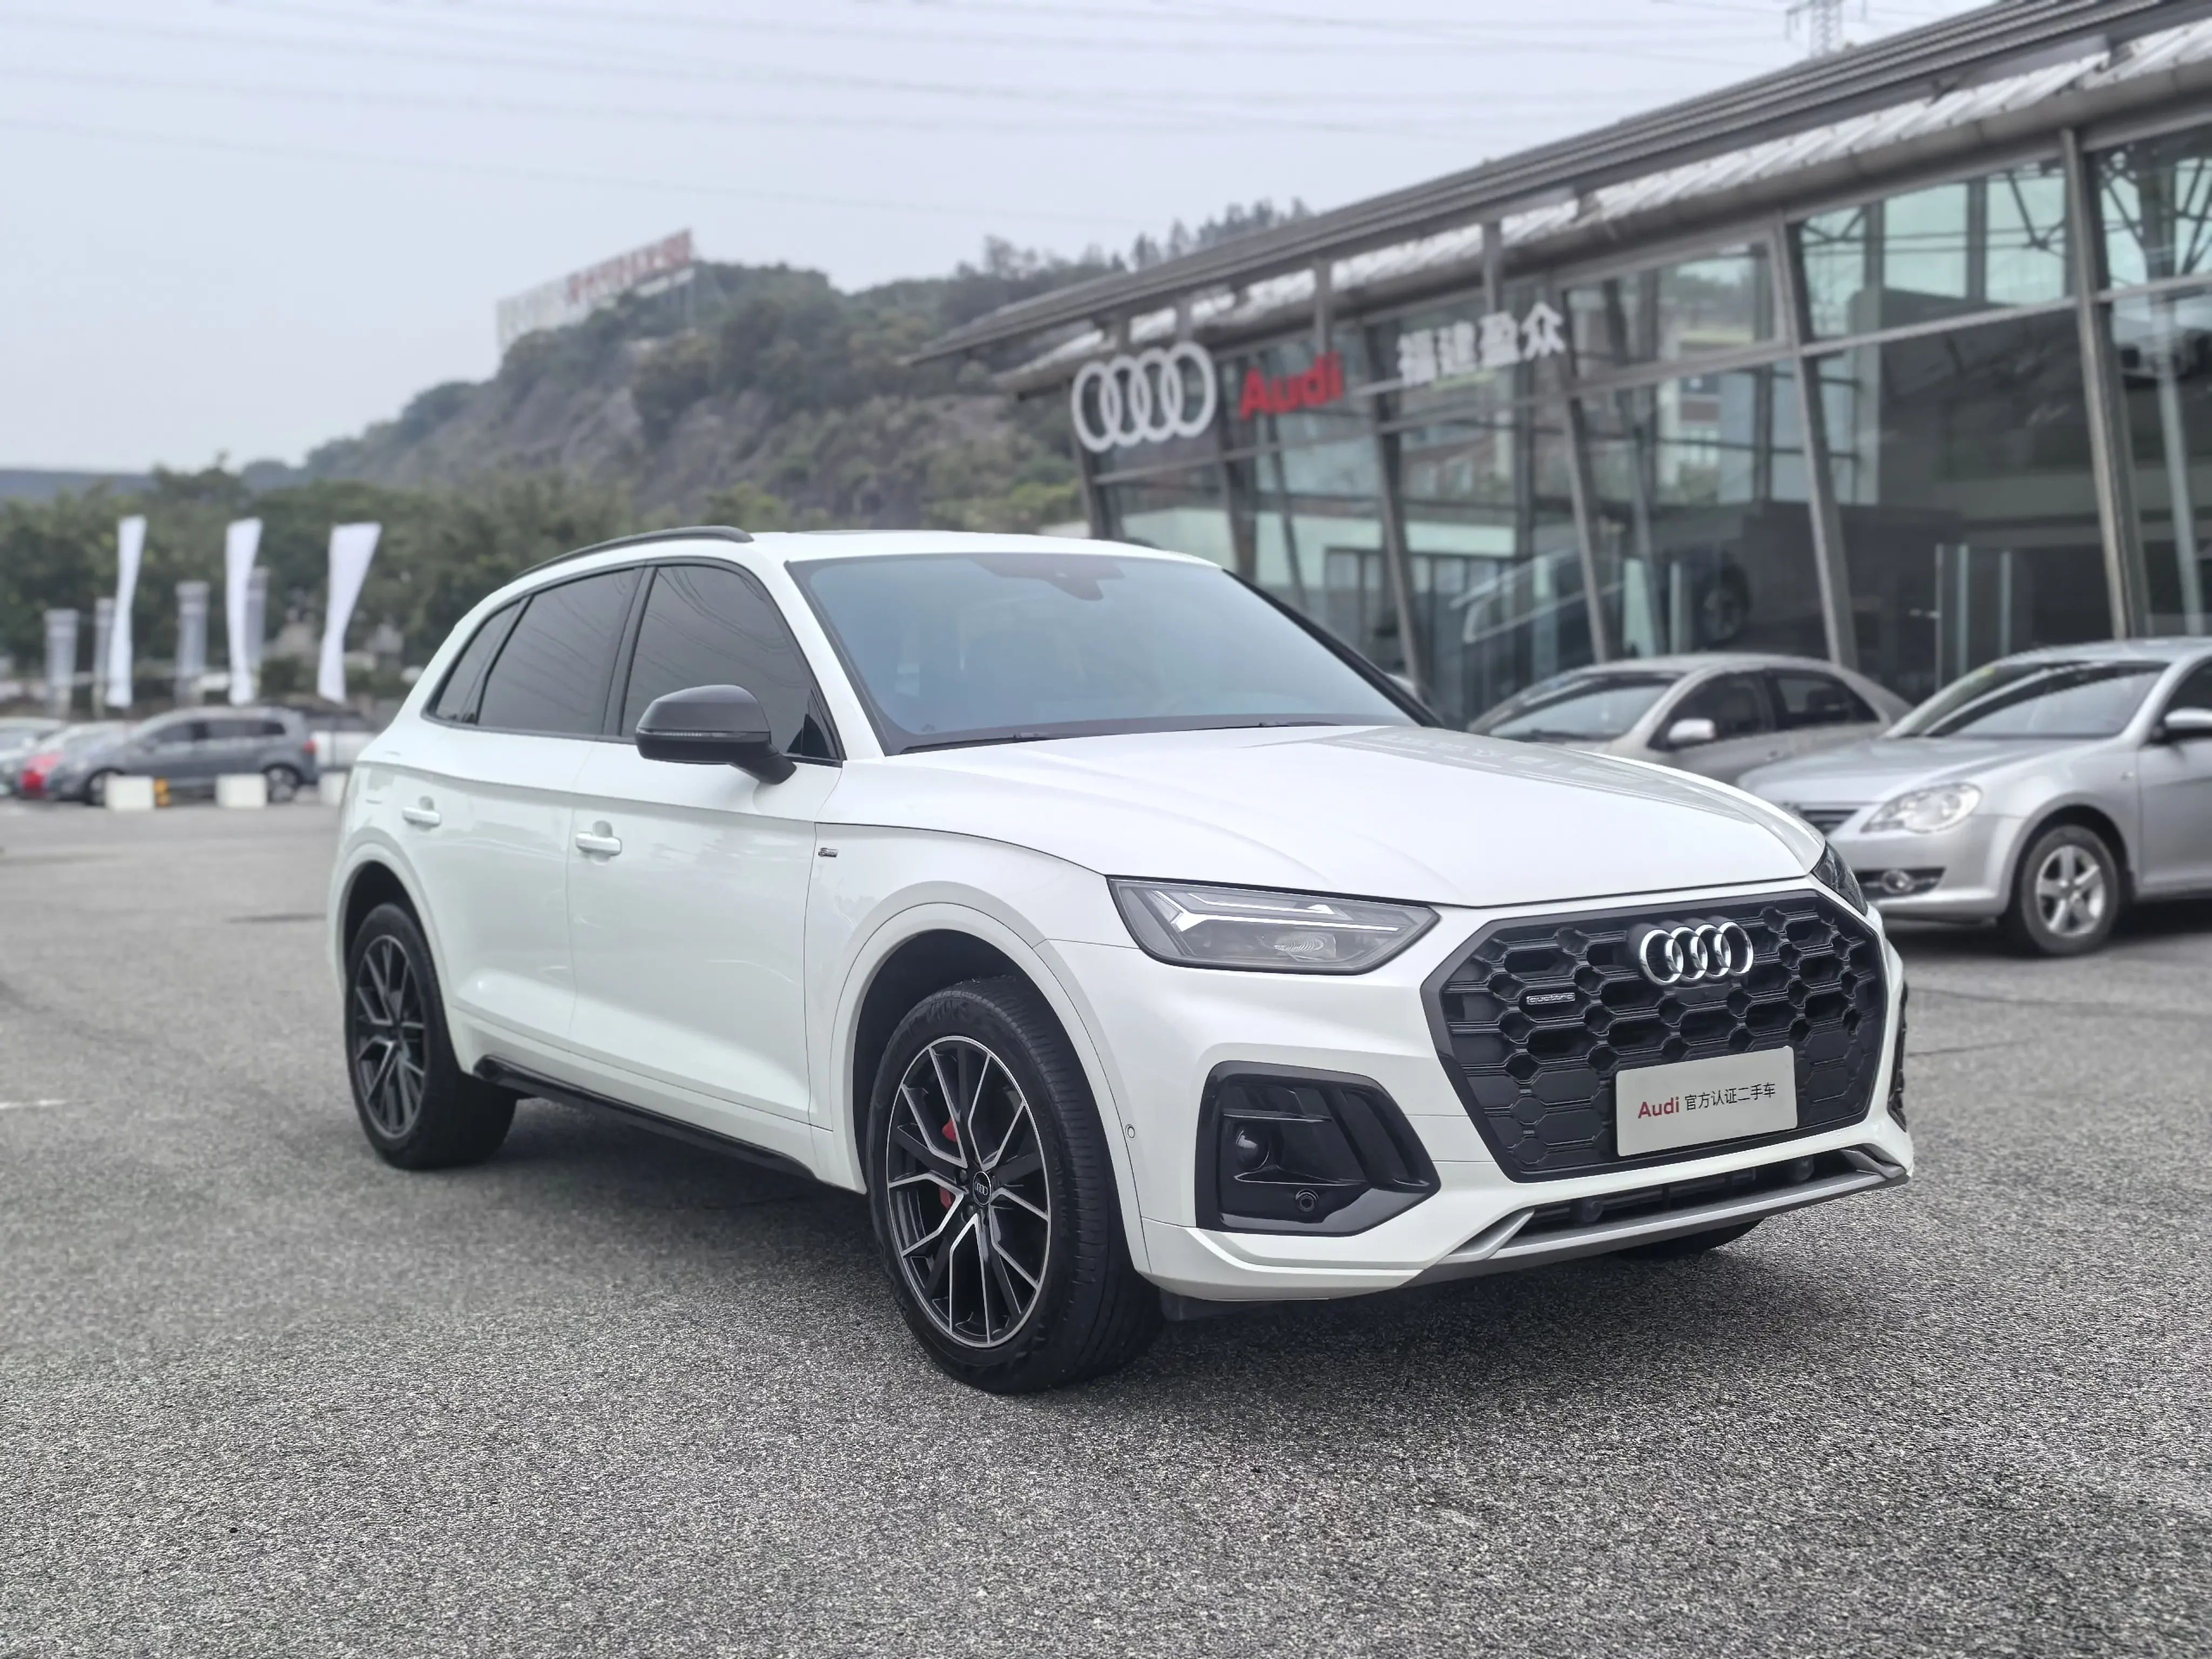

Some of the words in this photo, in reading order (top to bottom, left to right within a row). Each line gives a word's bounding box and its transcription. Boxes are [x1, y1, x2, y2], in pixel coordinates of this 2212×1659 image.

[1239, 349, 1344, 421] Audi
[1638, 1097, 1680, 1118] Audi
[1685, 1082, 1775, 1110] 官方认证二手车
